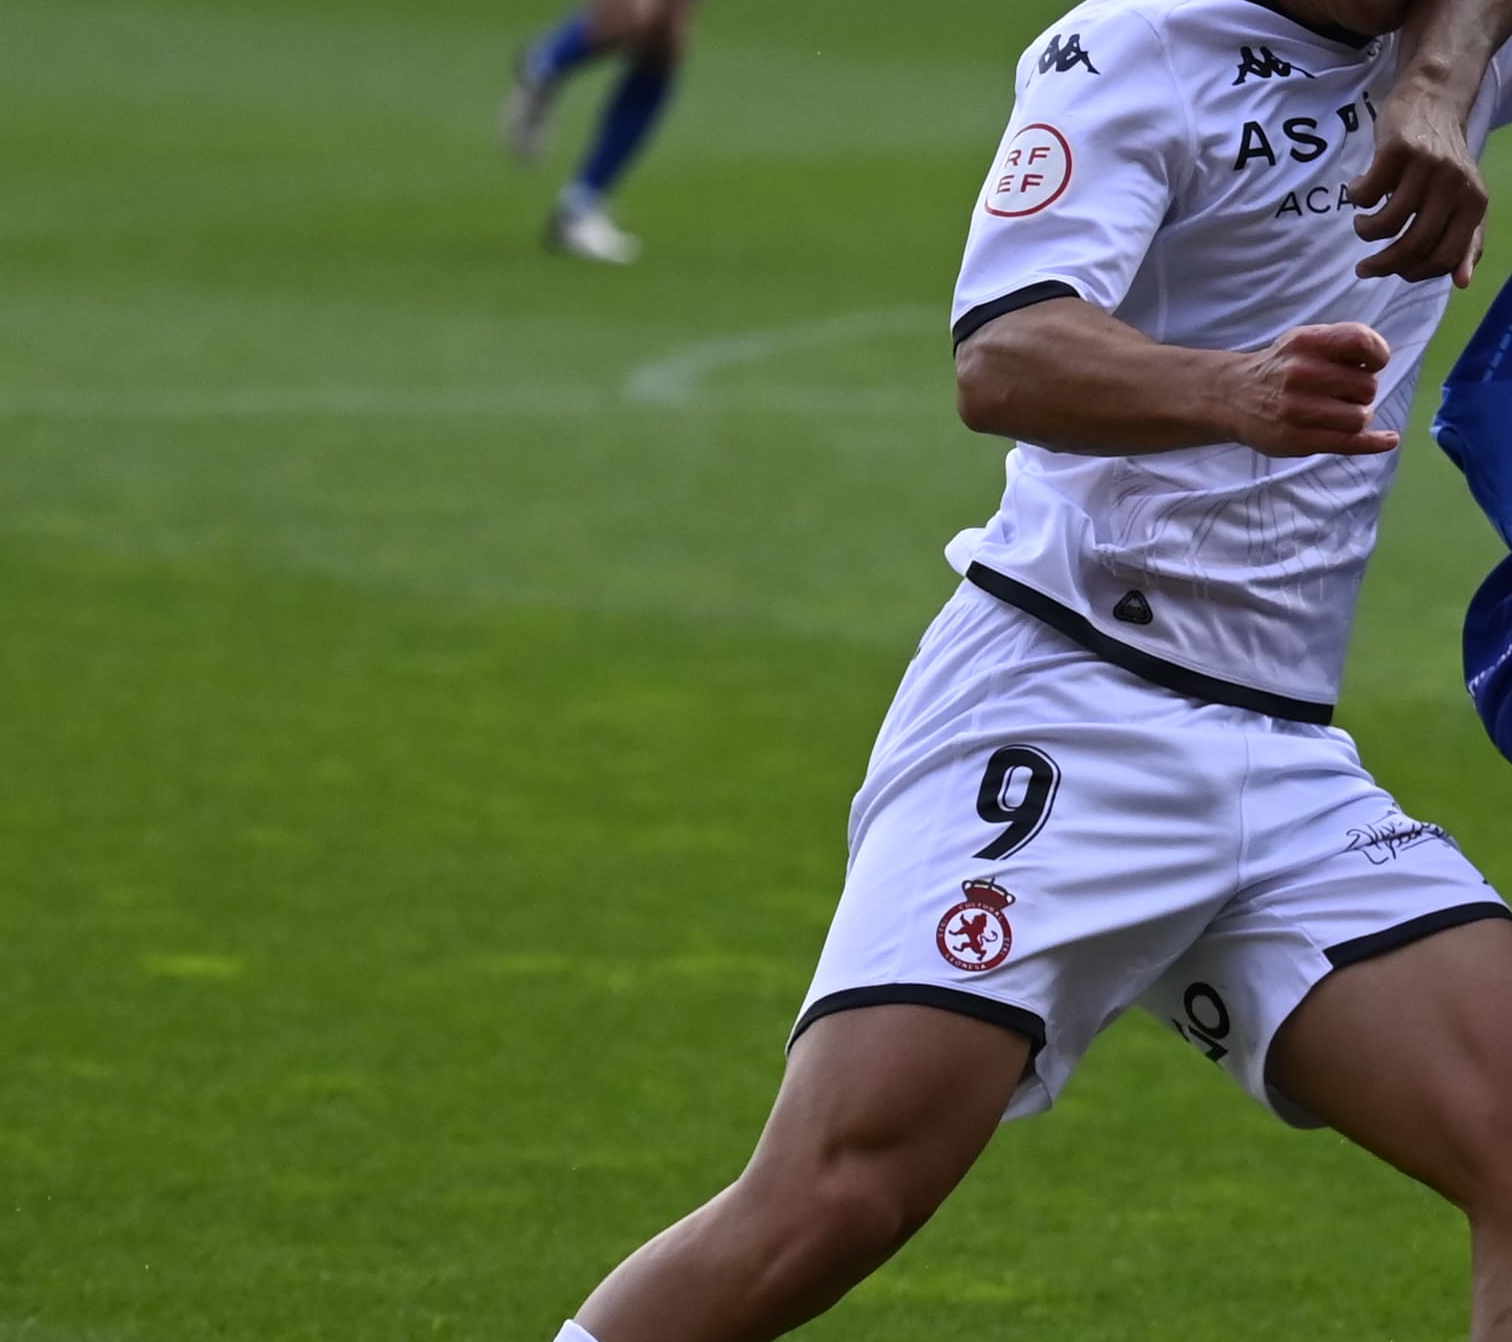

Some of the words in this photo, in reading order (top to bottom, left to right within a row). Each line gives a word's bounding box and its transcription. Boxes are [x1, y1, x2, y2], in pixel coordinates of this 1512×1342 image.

[1005, 146, 1051, 169] RF
[996, 173, 1044, 195] EF
[971, 744, 1061, 861] 9
[945, 952, 987, 970] LEONESA
